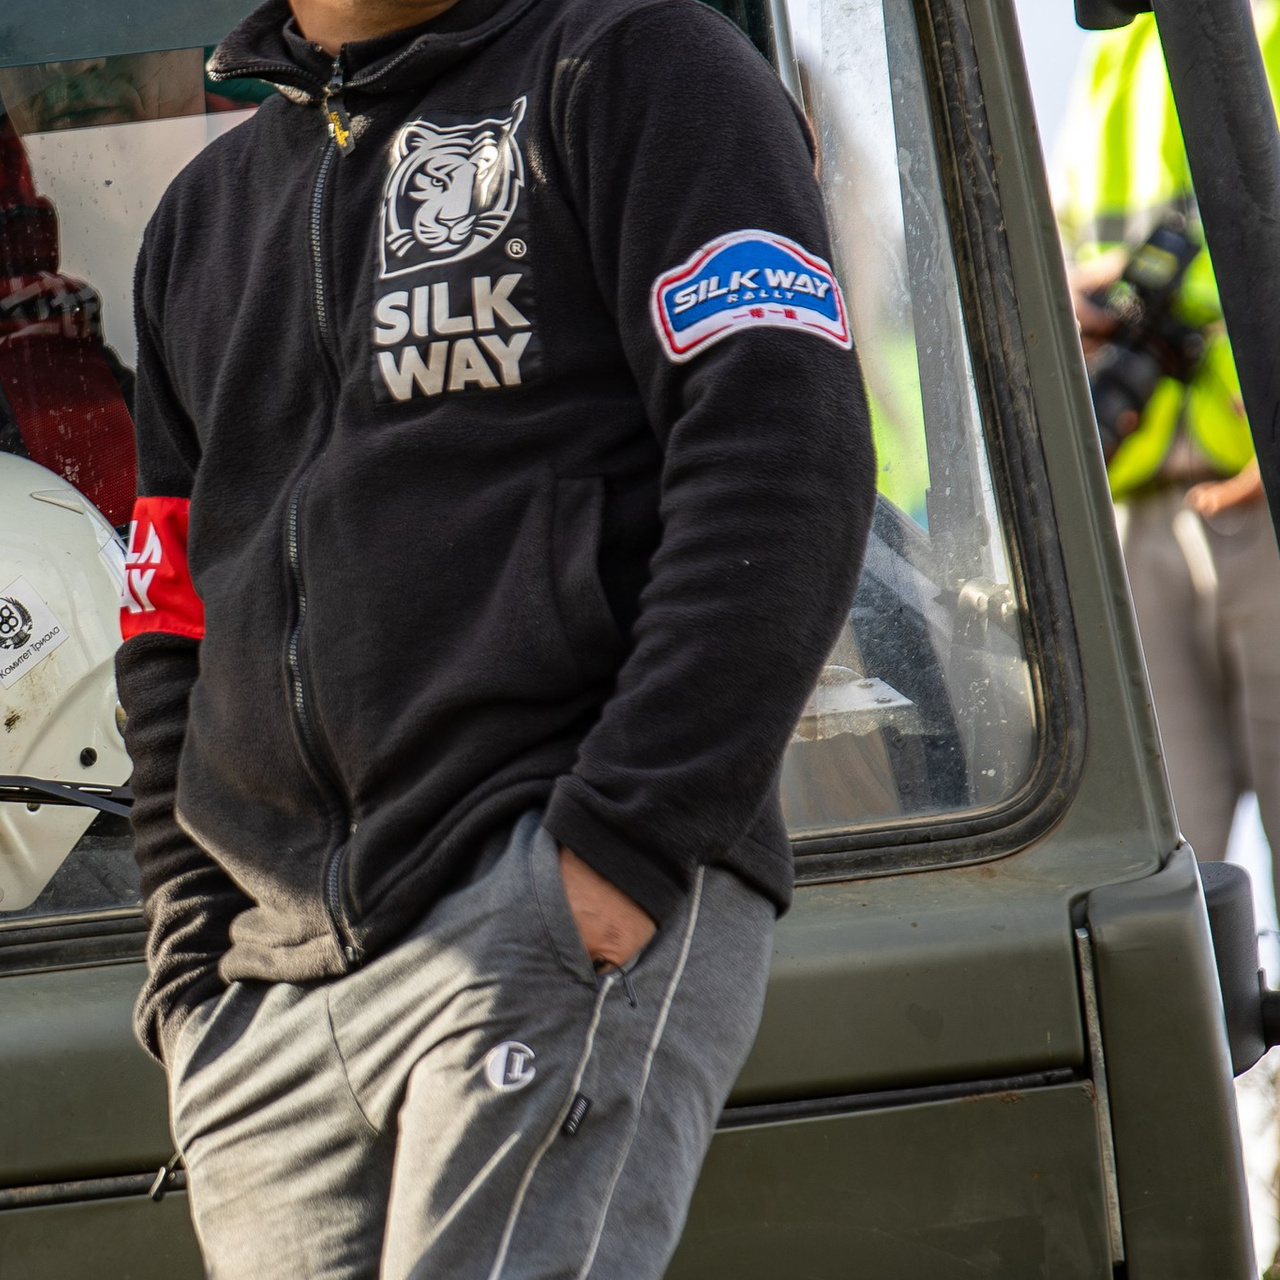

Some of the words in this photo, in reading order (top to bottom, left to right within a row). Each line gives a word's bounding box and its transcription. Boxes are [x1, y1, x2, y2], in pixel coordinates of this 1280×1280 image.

[373, 272, 532, 348] SILK
[672, 268, 760, 314] SILK
[764, 267, 831, 299] WAY
[726, 290, 795, 303] RALLY
[376, 331, 532, 403] WAY
[31, 626, 61, 652] Триала
